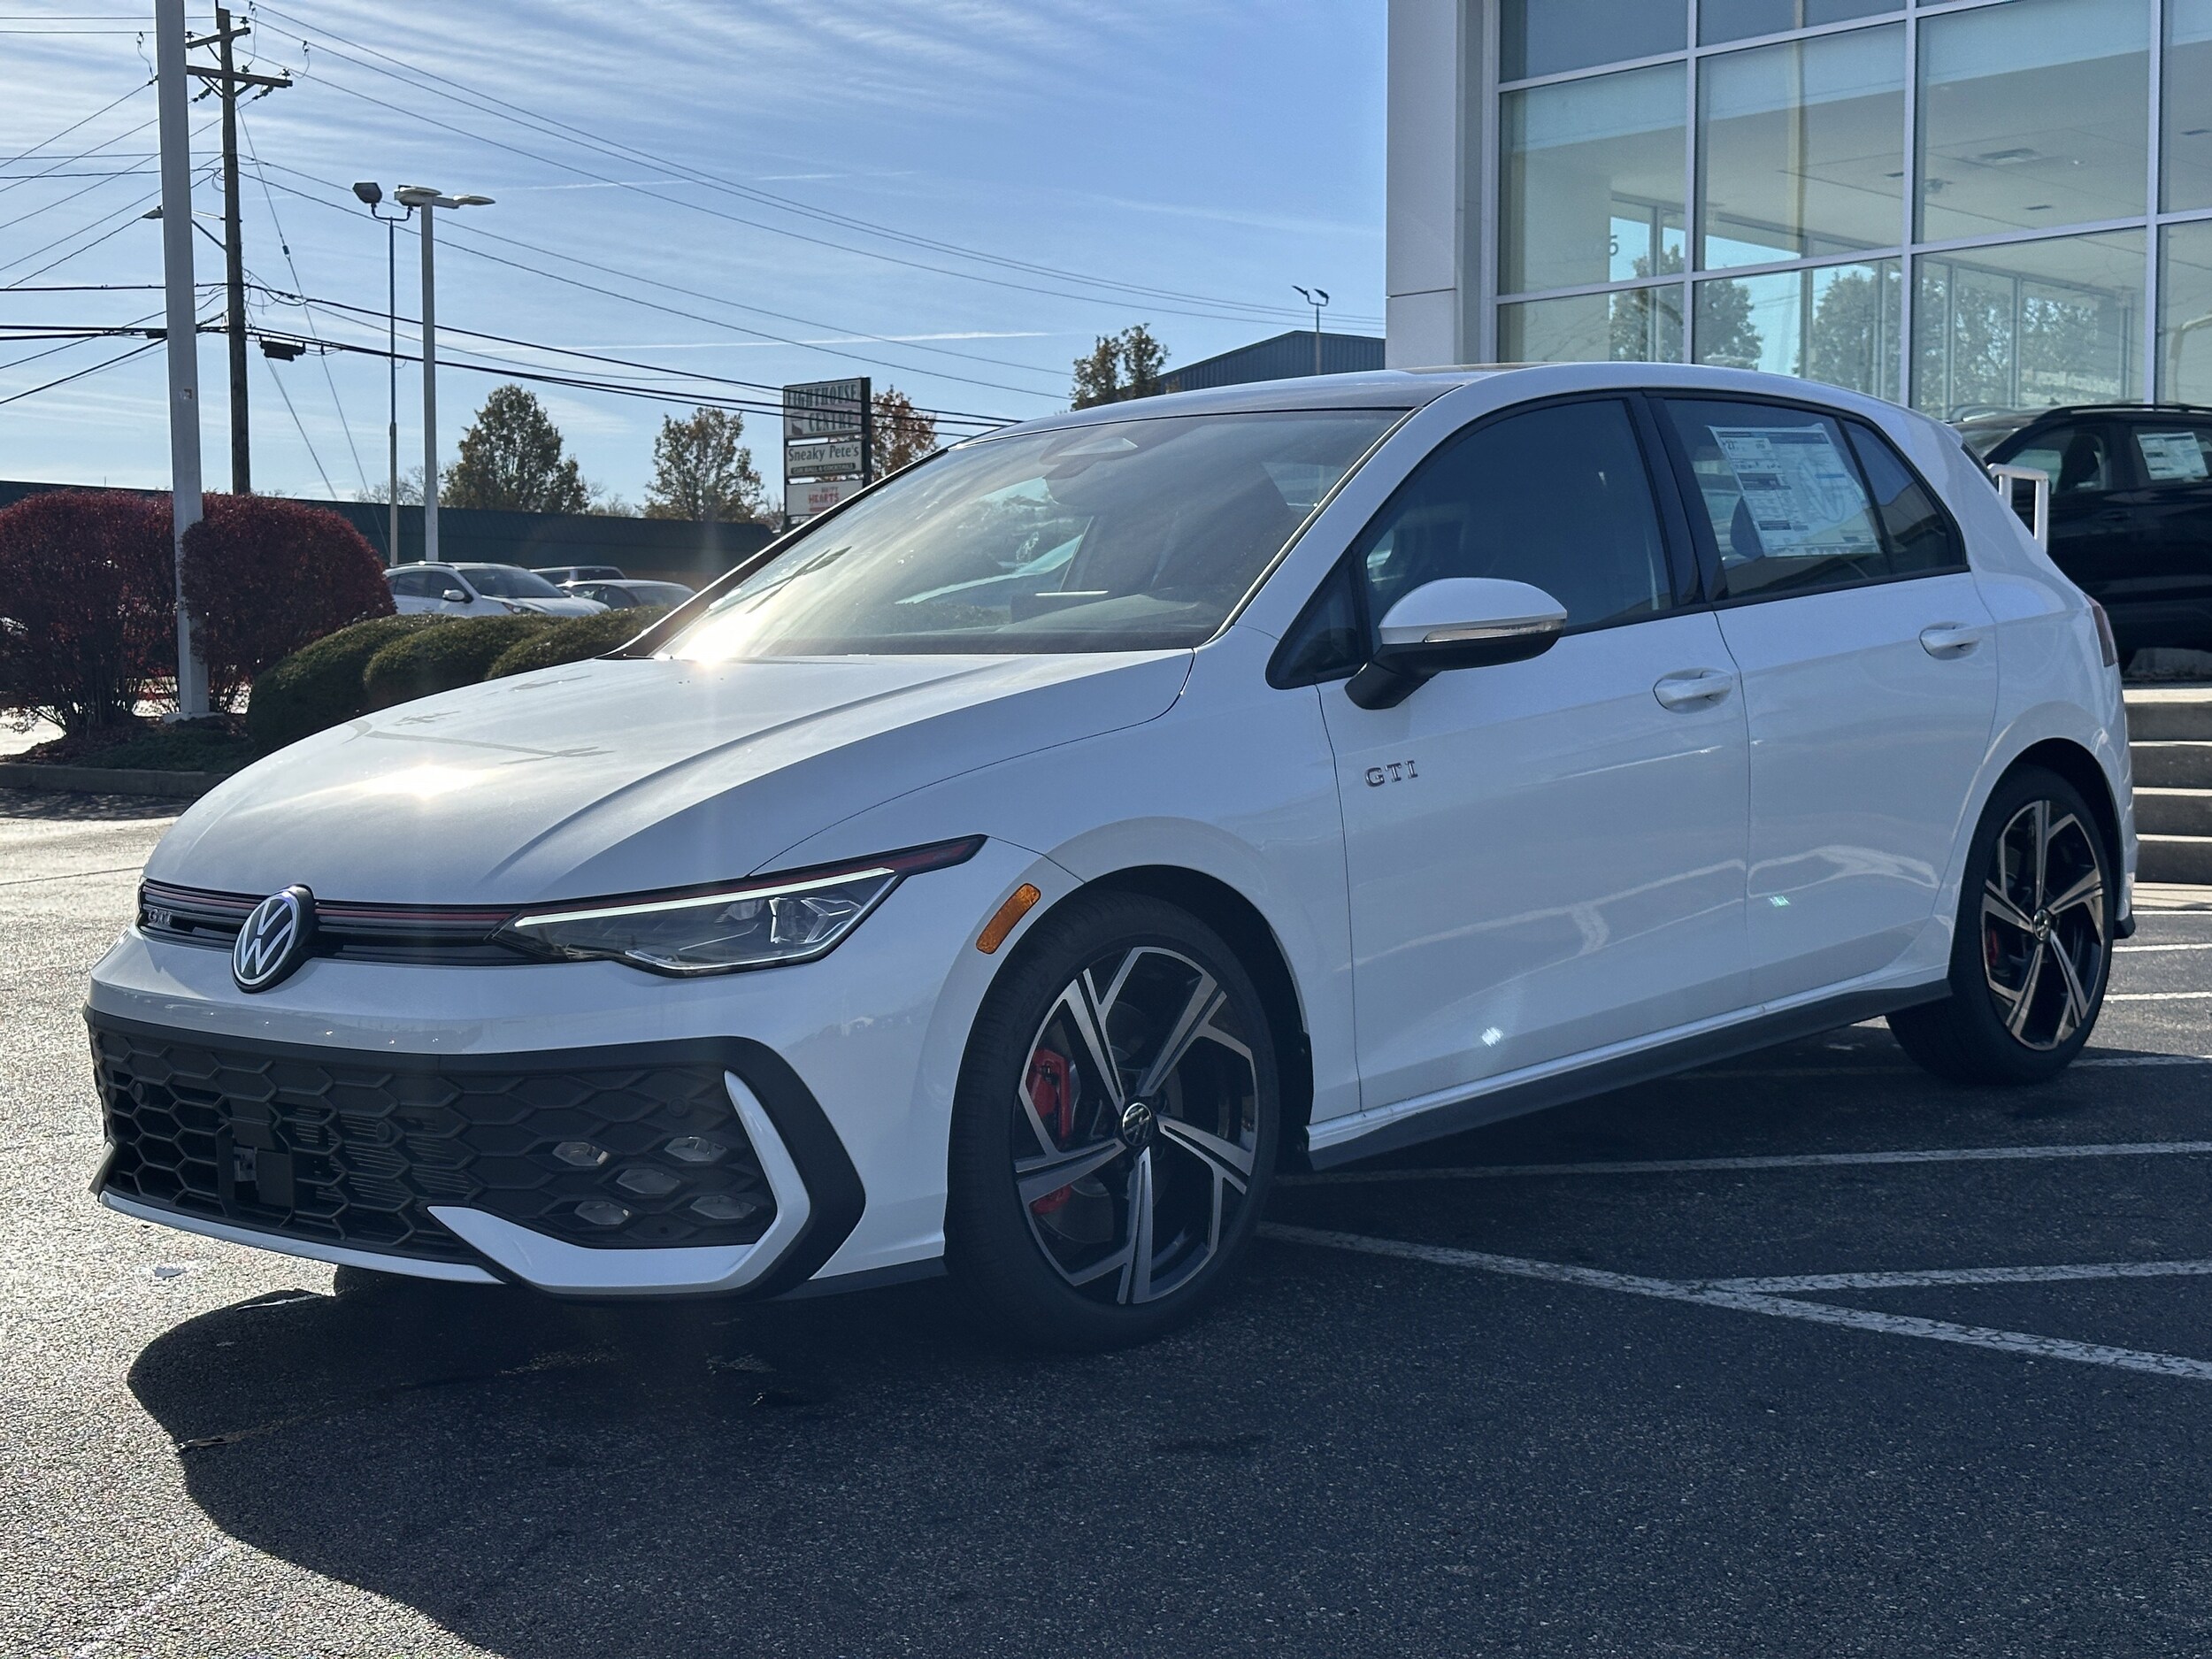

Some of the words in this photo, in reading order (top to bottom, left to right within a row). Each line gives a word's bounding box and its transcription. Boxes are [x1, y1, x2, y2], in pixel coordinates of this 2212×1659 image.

[809, 410, 854, 432] CENTRE
[788, 447, 826, 462] Sneaky
[829, 444, 859, 457] Pete's
[809, 492, 840, 503] HEARTS
[1365, 760, 1418, 787] GTI
[148, 908, 173, 926] GTI
